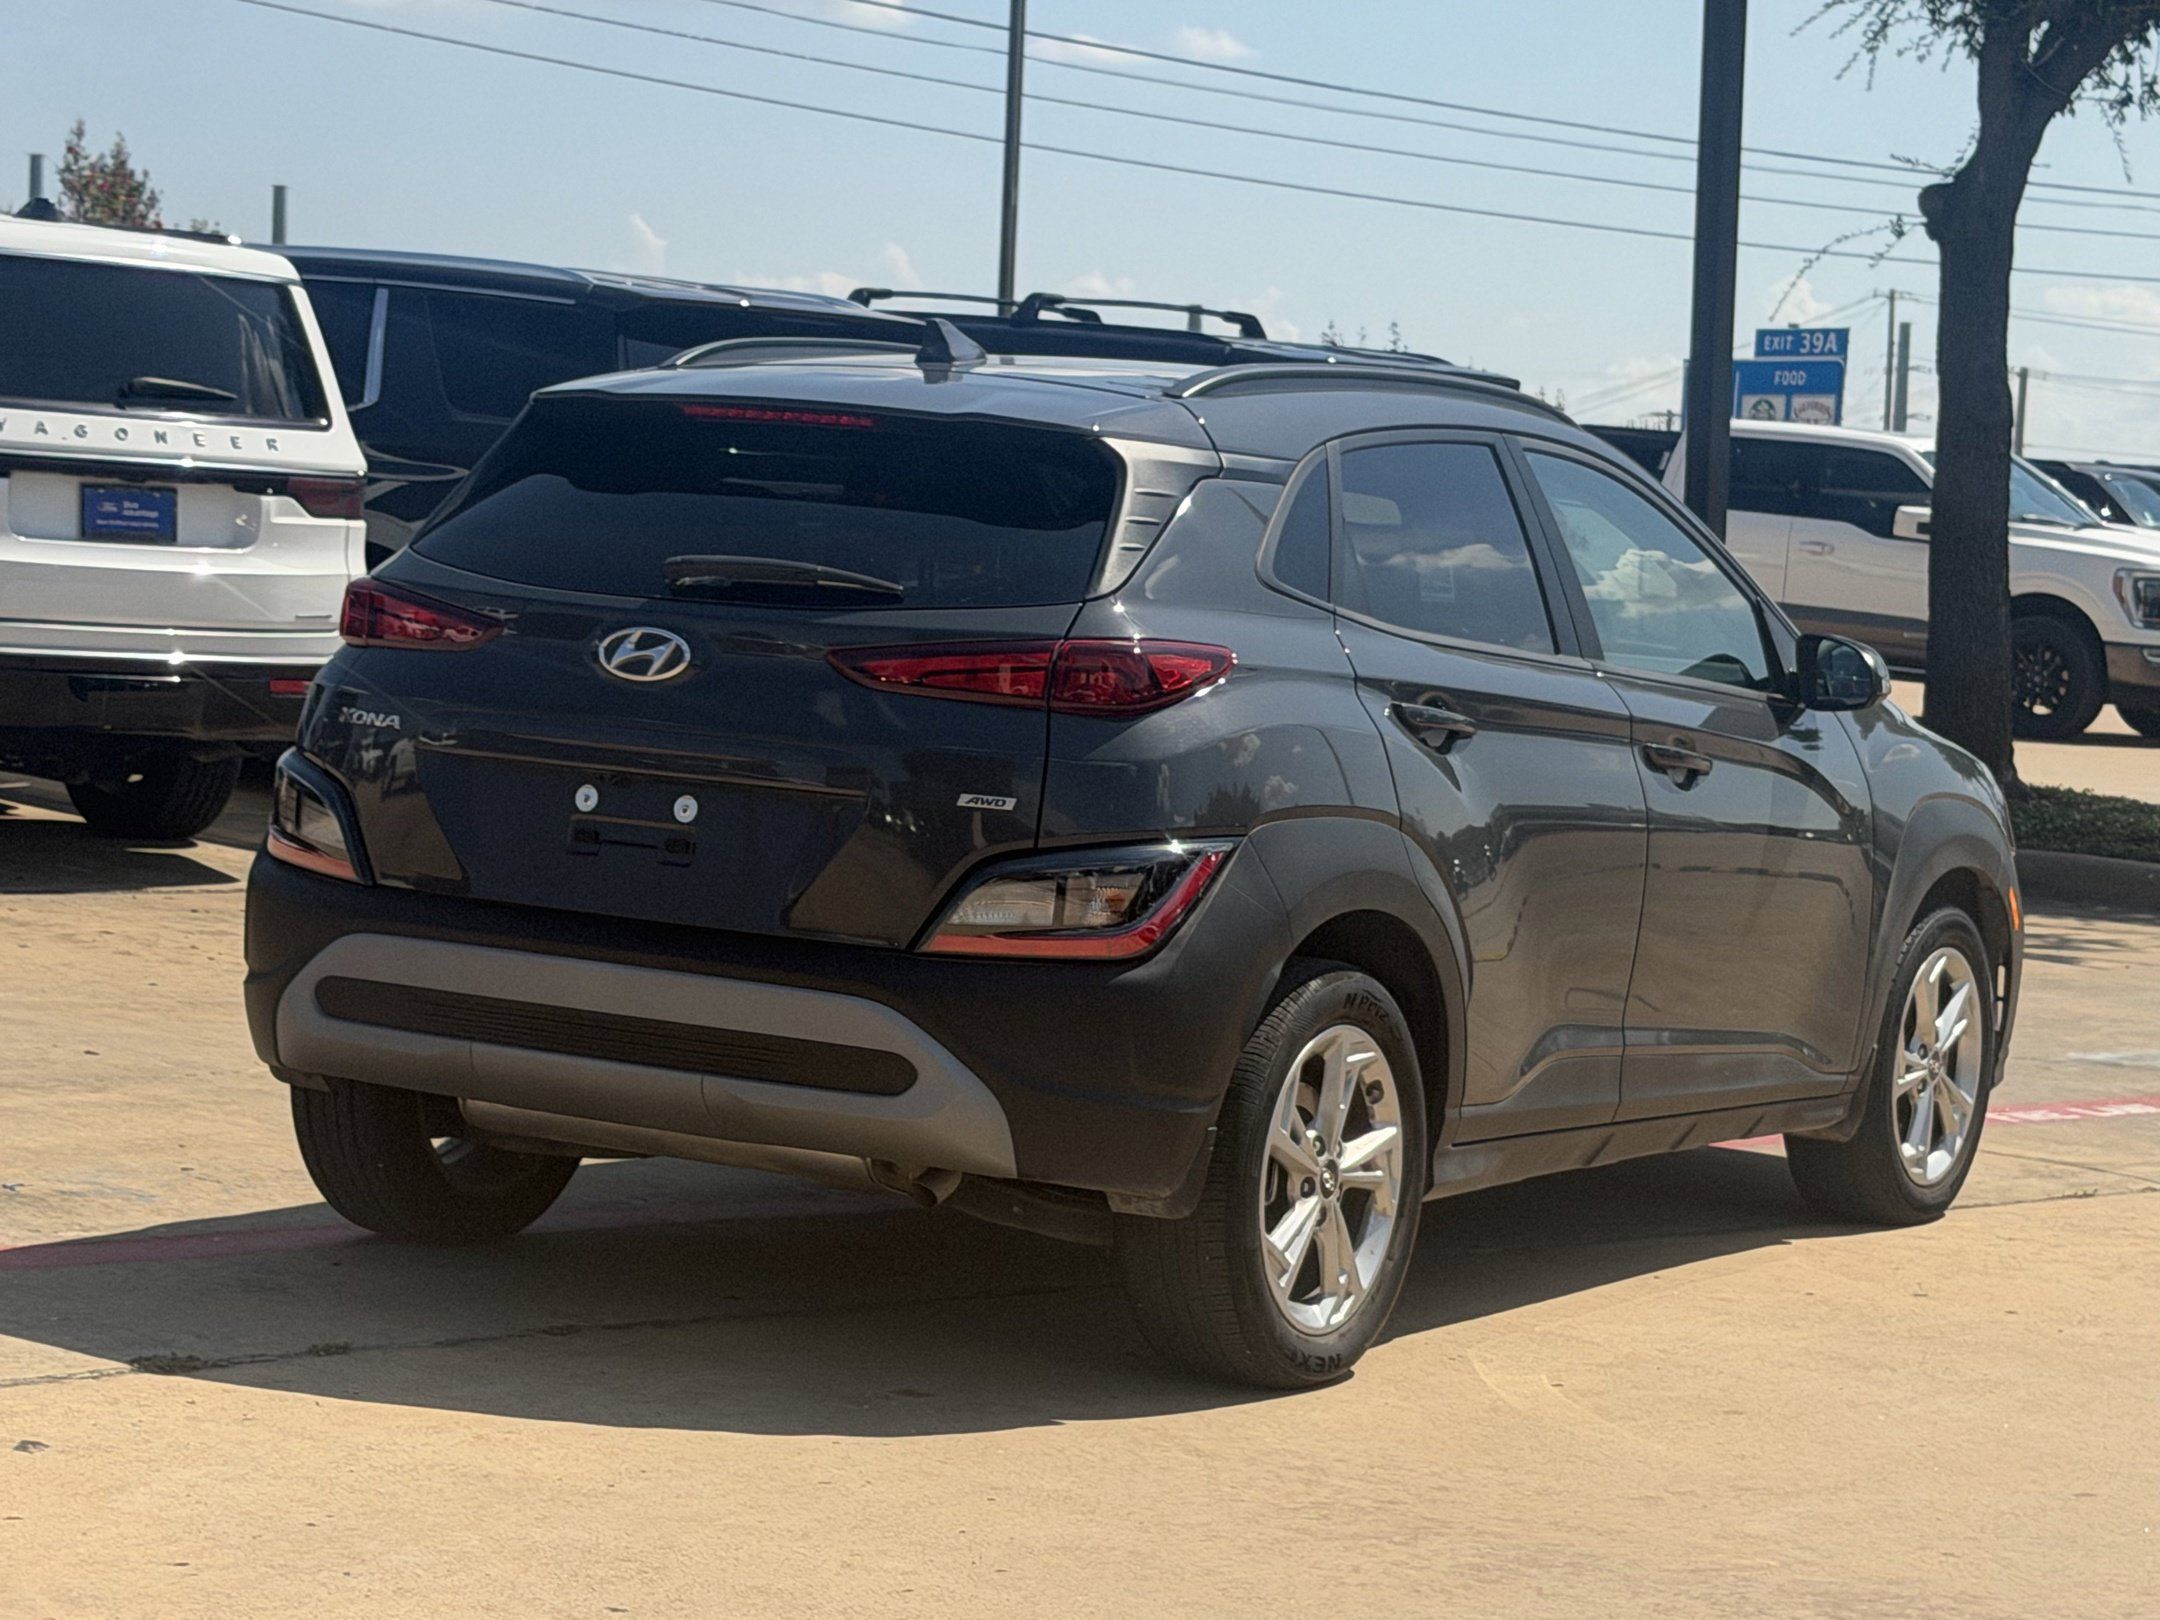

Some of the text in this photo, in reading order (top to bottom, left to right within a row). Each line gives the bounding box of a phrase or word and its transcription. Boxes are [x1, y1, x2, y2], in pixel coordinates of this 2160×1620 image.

[1764, 332, 1838, 354] EXIT 39A
[1773, 370, 1807, 386] FOOD
[339, 706, 400, 730] KONA
[963, 796, 1009, 808] AWD
